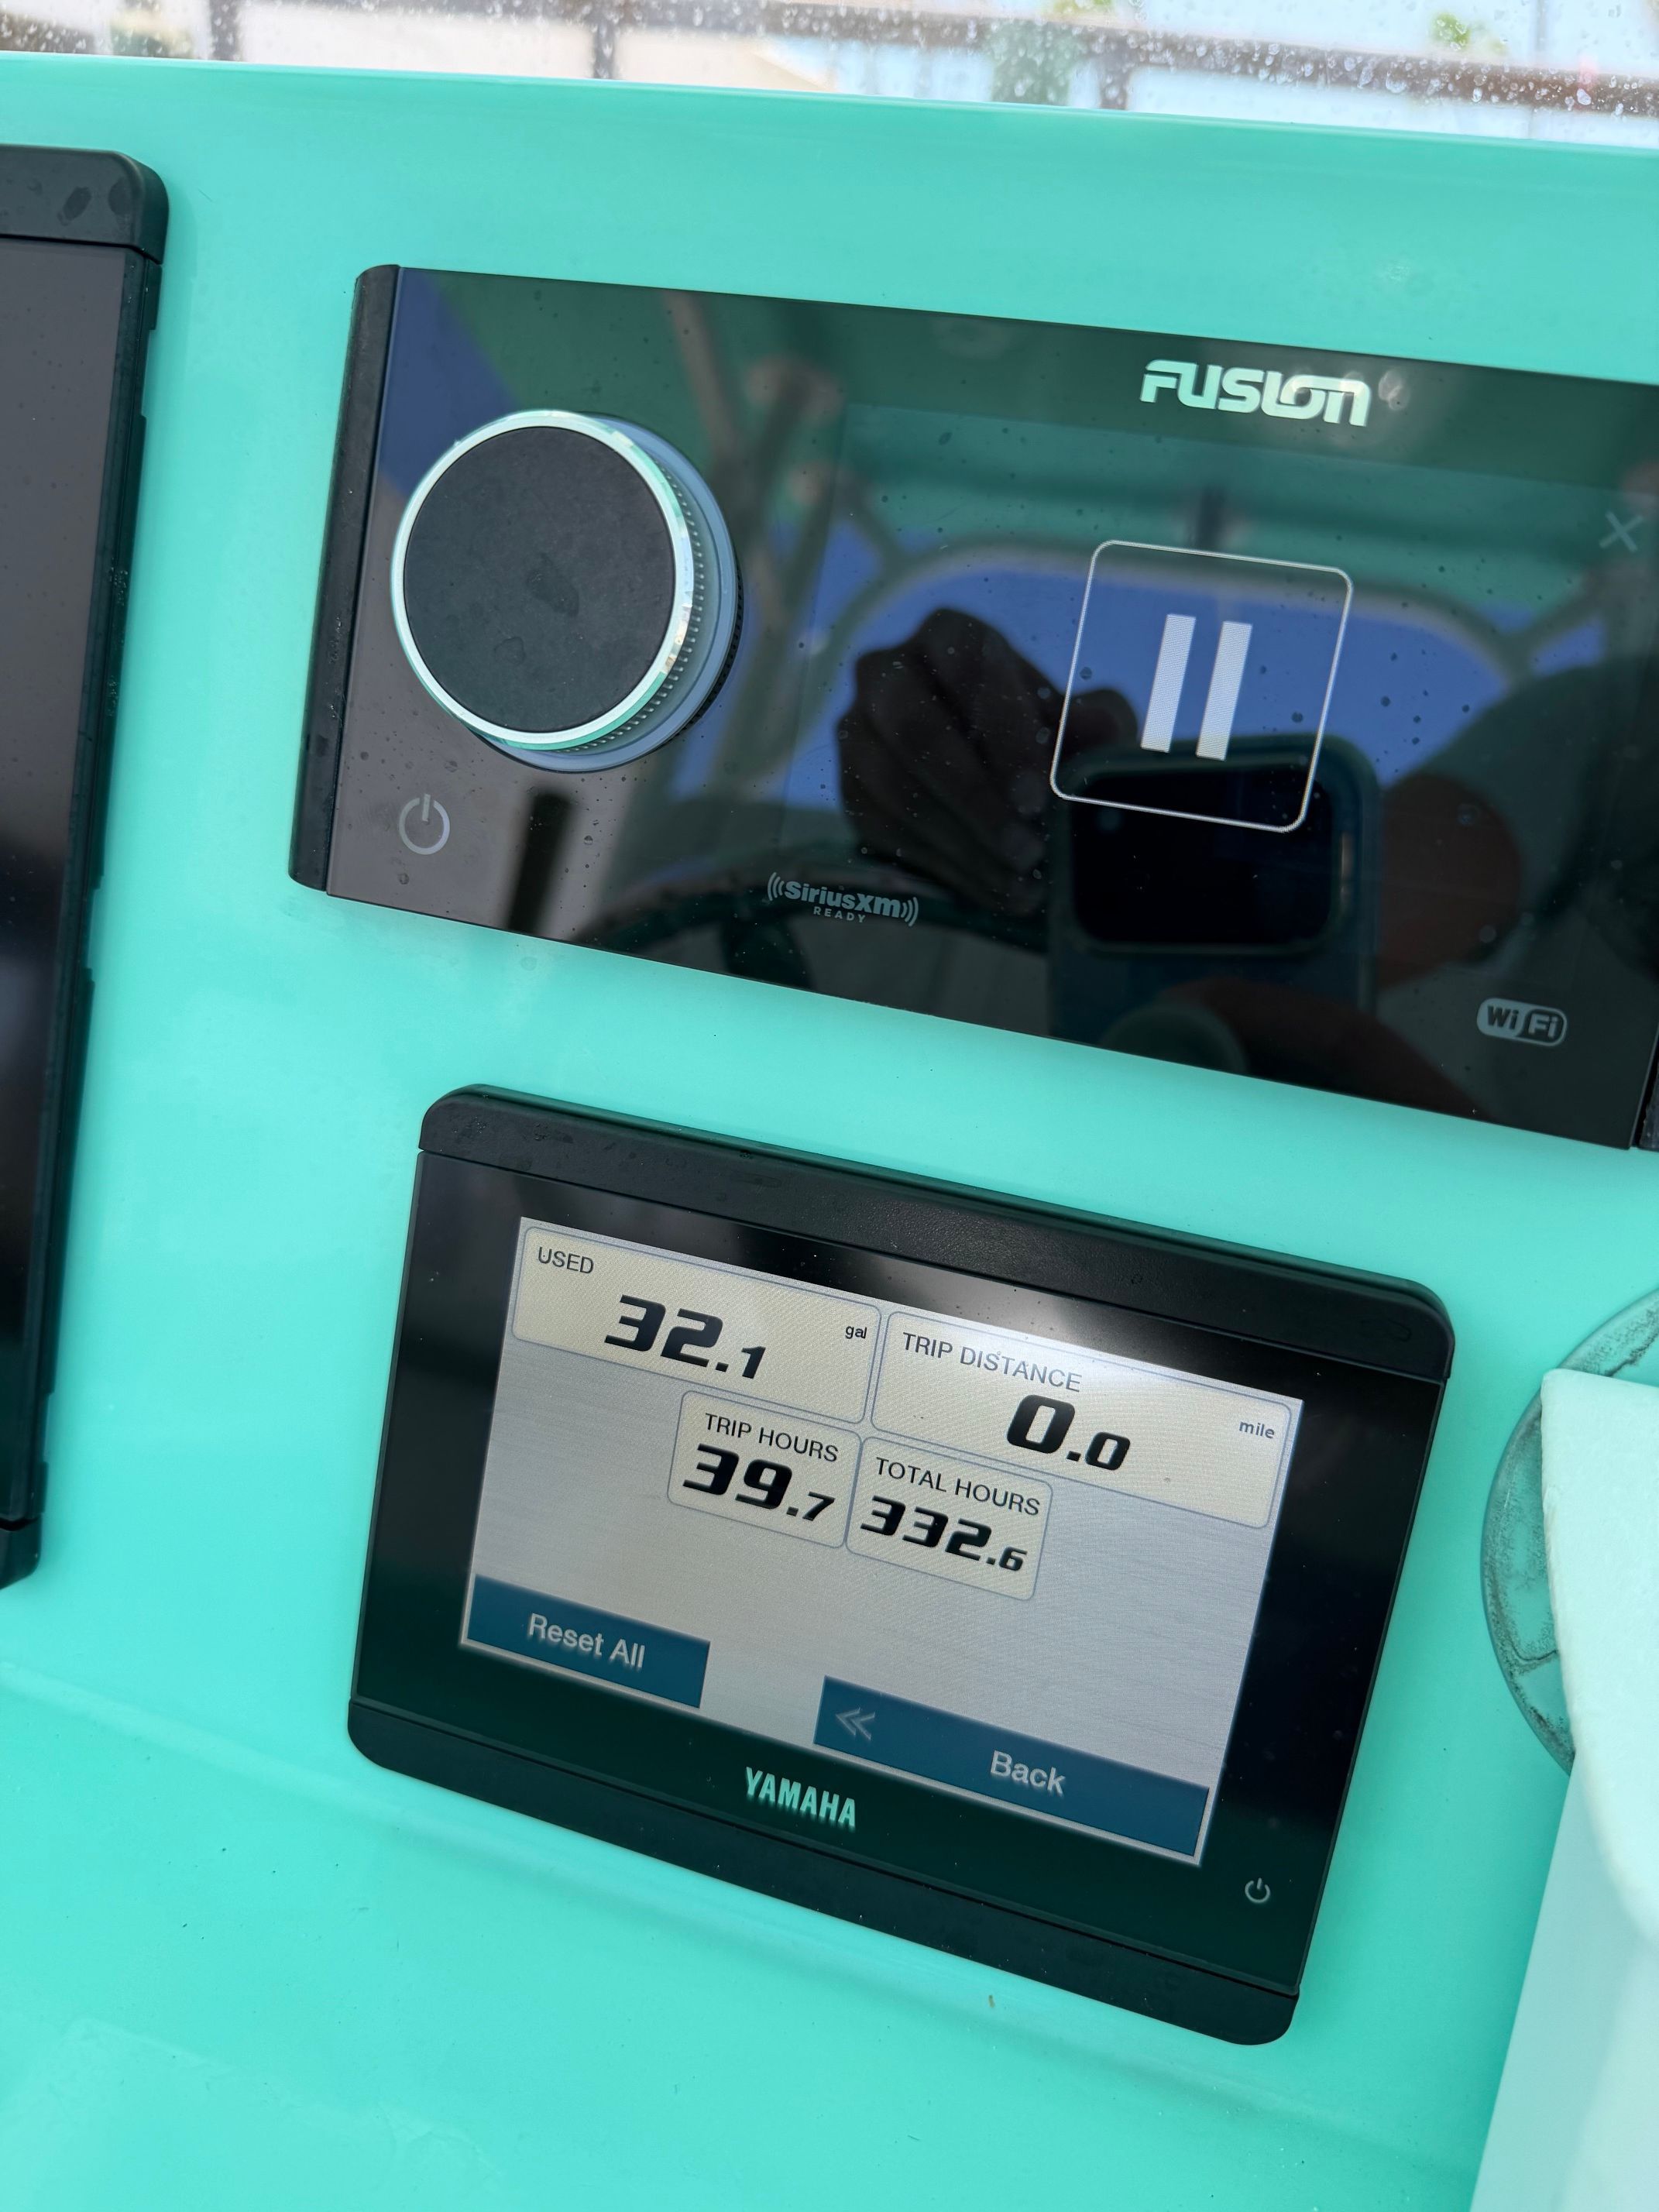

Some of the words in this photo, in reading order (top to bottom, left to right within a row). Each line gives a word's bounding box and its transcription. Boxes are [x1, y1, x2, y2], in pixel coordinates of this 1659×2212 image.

[1140, 359, 1371, 427] FUSION
[813, 905, 866, 923] READY
[537, 1245, 595, 1275] USED
[604, 1293, 766, 1379] 32.1
[844, 1324, 868, 1341] gal
[902, 1331, 953, 1359] TRIP
[959, 1345, 1083, 1393] DISTANCE
[705, 1412, 752, 1439] TRIP
[758, 1427, 840, 1463] HOURS
[1006, 1393, 1132, 1472] 0.0
[1238, 1419, 1276, 1441] mile
[682, 1442, 835, 1522] 39.7
[875, 1456, 948, 1493] TOTAL
[954, 1477, 1041, 1517] HOURS
[860, 1494, 1028, 1573] 332.6
[527, 1613, 604, 1657] Reset
[609, 1637, 645, 1671] All
[745, 1766, 857, 1829] YAMAHA
[989, 1750, 1066, 1796] Back
